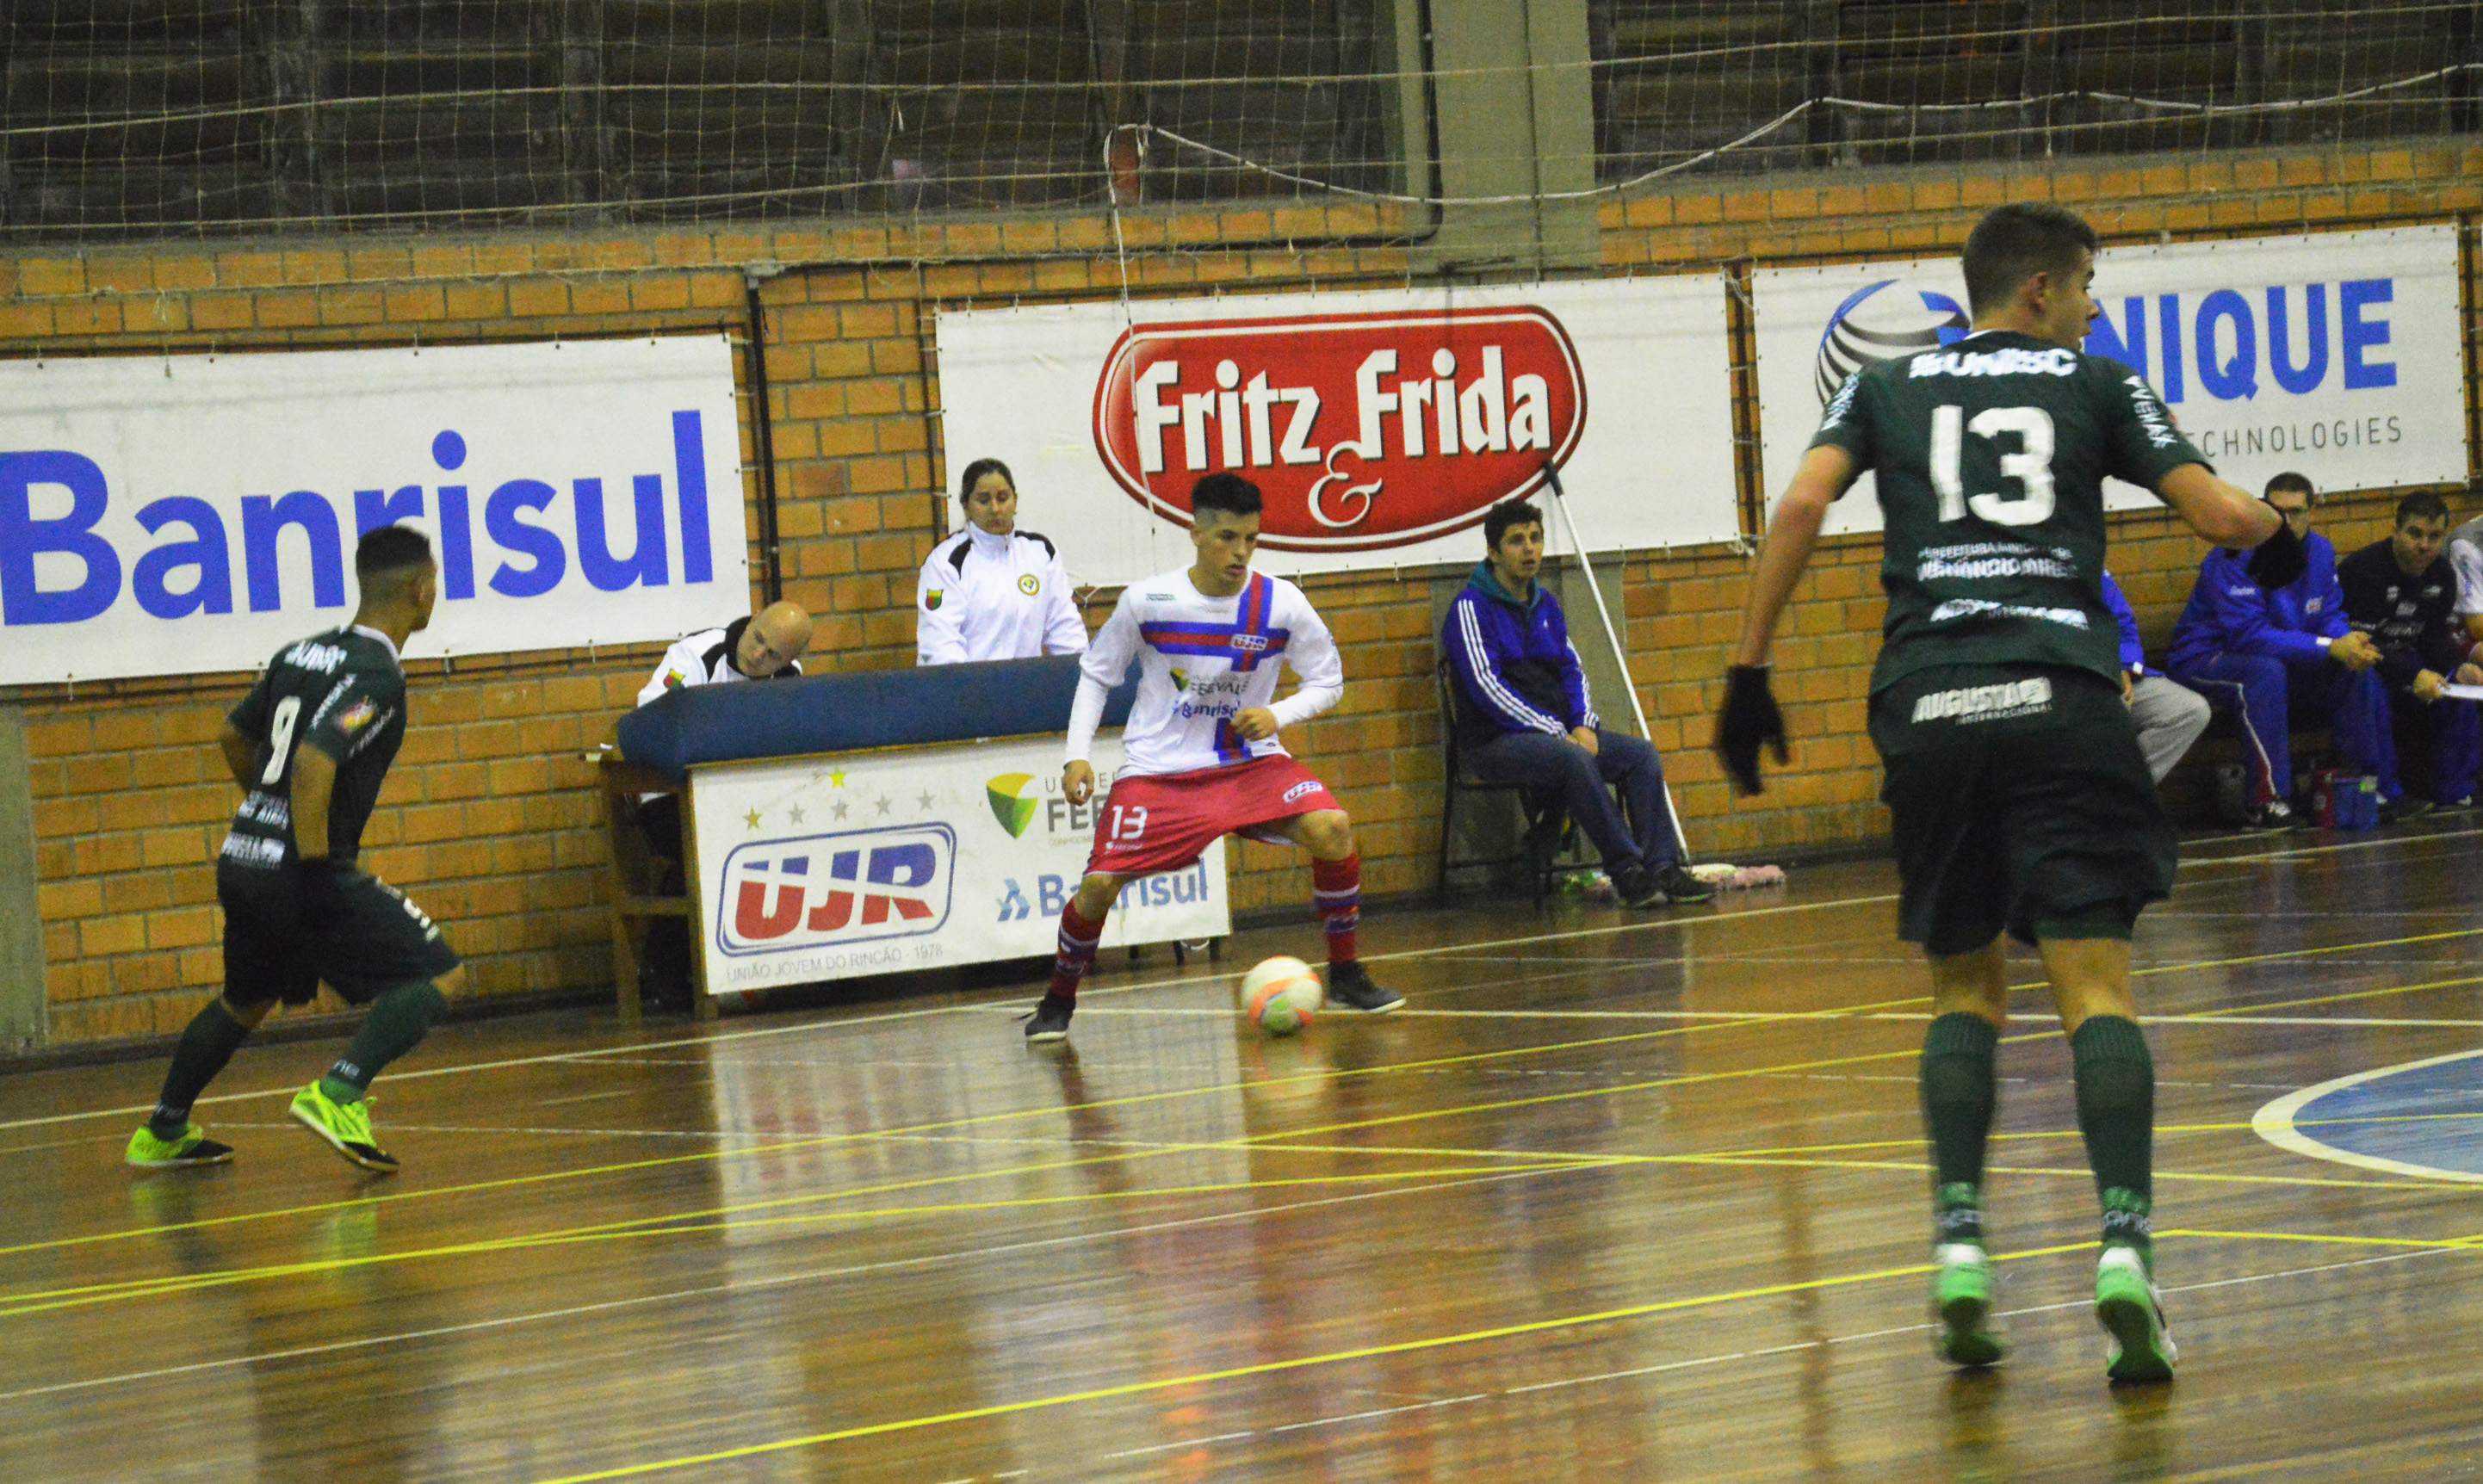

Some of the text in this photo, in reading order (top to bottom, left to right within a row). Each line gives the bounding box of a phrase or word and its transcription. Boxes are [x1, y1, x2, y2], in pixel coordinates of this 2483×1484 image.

[2084, 278, 2397, 405] NIQUE
[1134, 359, 1322, 473] Fritz
[1356, 344, 1551, 461] Frida
[2185, 415, 2402, 458] CHNOLOGIES
[1308, 440, 1384, 529] &
[1929, 404, 2056, 527] 13
[0, 409, 713, 627] Banrisul
[261, 695, 301, 785] 9
[1111, 805, 1149, 840] 13
[734, 842, 937, 941] UJR
[727, 962, 771, 983] UNIÃO
[775, 959, 822, 979] JOVEM
[825, 955, 846, 971] DO
[850, 947, 902, 968] RINCÃO
[915, 943, 944, 960] 1978
